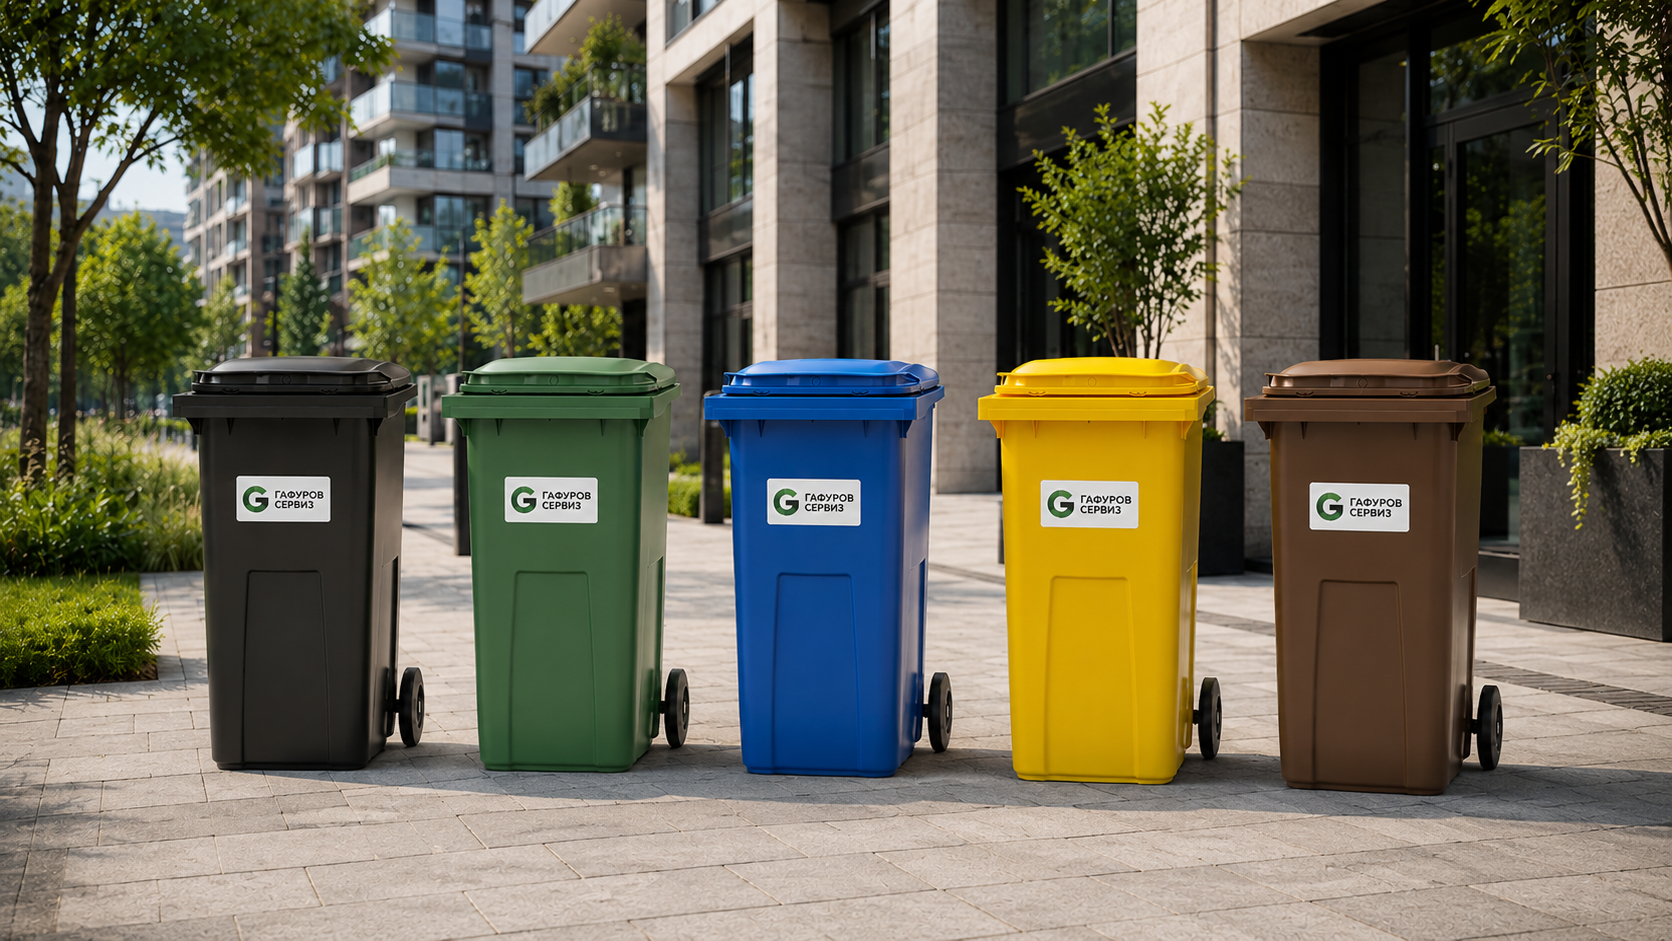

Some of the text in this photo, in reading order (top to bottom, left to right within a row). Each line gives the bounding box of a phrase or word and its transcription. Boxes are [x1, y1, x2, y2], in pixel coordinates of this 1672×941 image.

[242, 485, 270, 514] G
[275, 490, 325, 500] ГАФУРОВ
[510, 486, 538, 514] G
[542, 491, 592, 500] ГАФУРОВ
[804, 493, 855, 503] ГАФУРОВ
[1080, 495, 1132, 505] ГАФУРОВ
[275, 500, 315, 509] СЕРВИЗ
[542, 501, 582, 510] СЕРВИЗ
[773, 488, 800, 517] G
[804, 503, 845, 512] СЕРВИЗ
[1047, 490, 1076, 519] G
[1315, 493, 1344, 521] G
[1350, 498, 1403, 508] ГАФУРОВ
[1080, 505, 1122, 514] СЕРВИЗ
[1350, 508, 1392, 518] СЕРВИЗ
